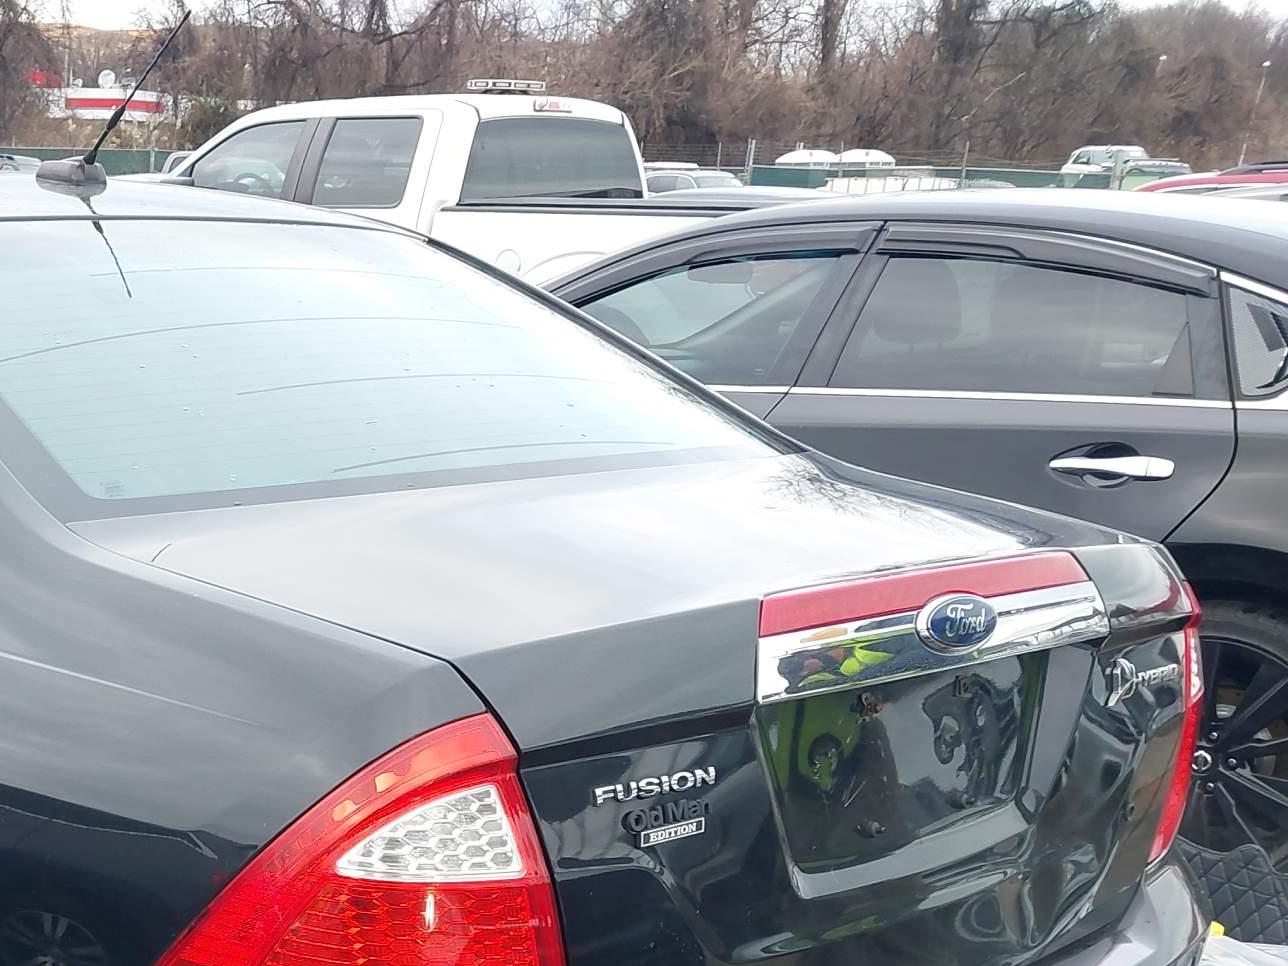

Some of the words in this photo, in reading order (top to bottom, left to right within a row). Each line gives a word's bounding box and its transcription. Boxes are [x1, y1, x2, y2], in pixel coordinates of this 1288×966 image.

[945, 603, 986, 638] Ford
[593, 766, 717, 807] FUSION
[623, 805, 665, 834] Old
[648, 822, 697, 842] EDITION
